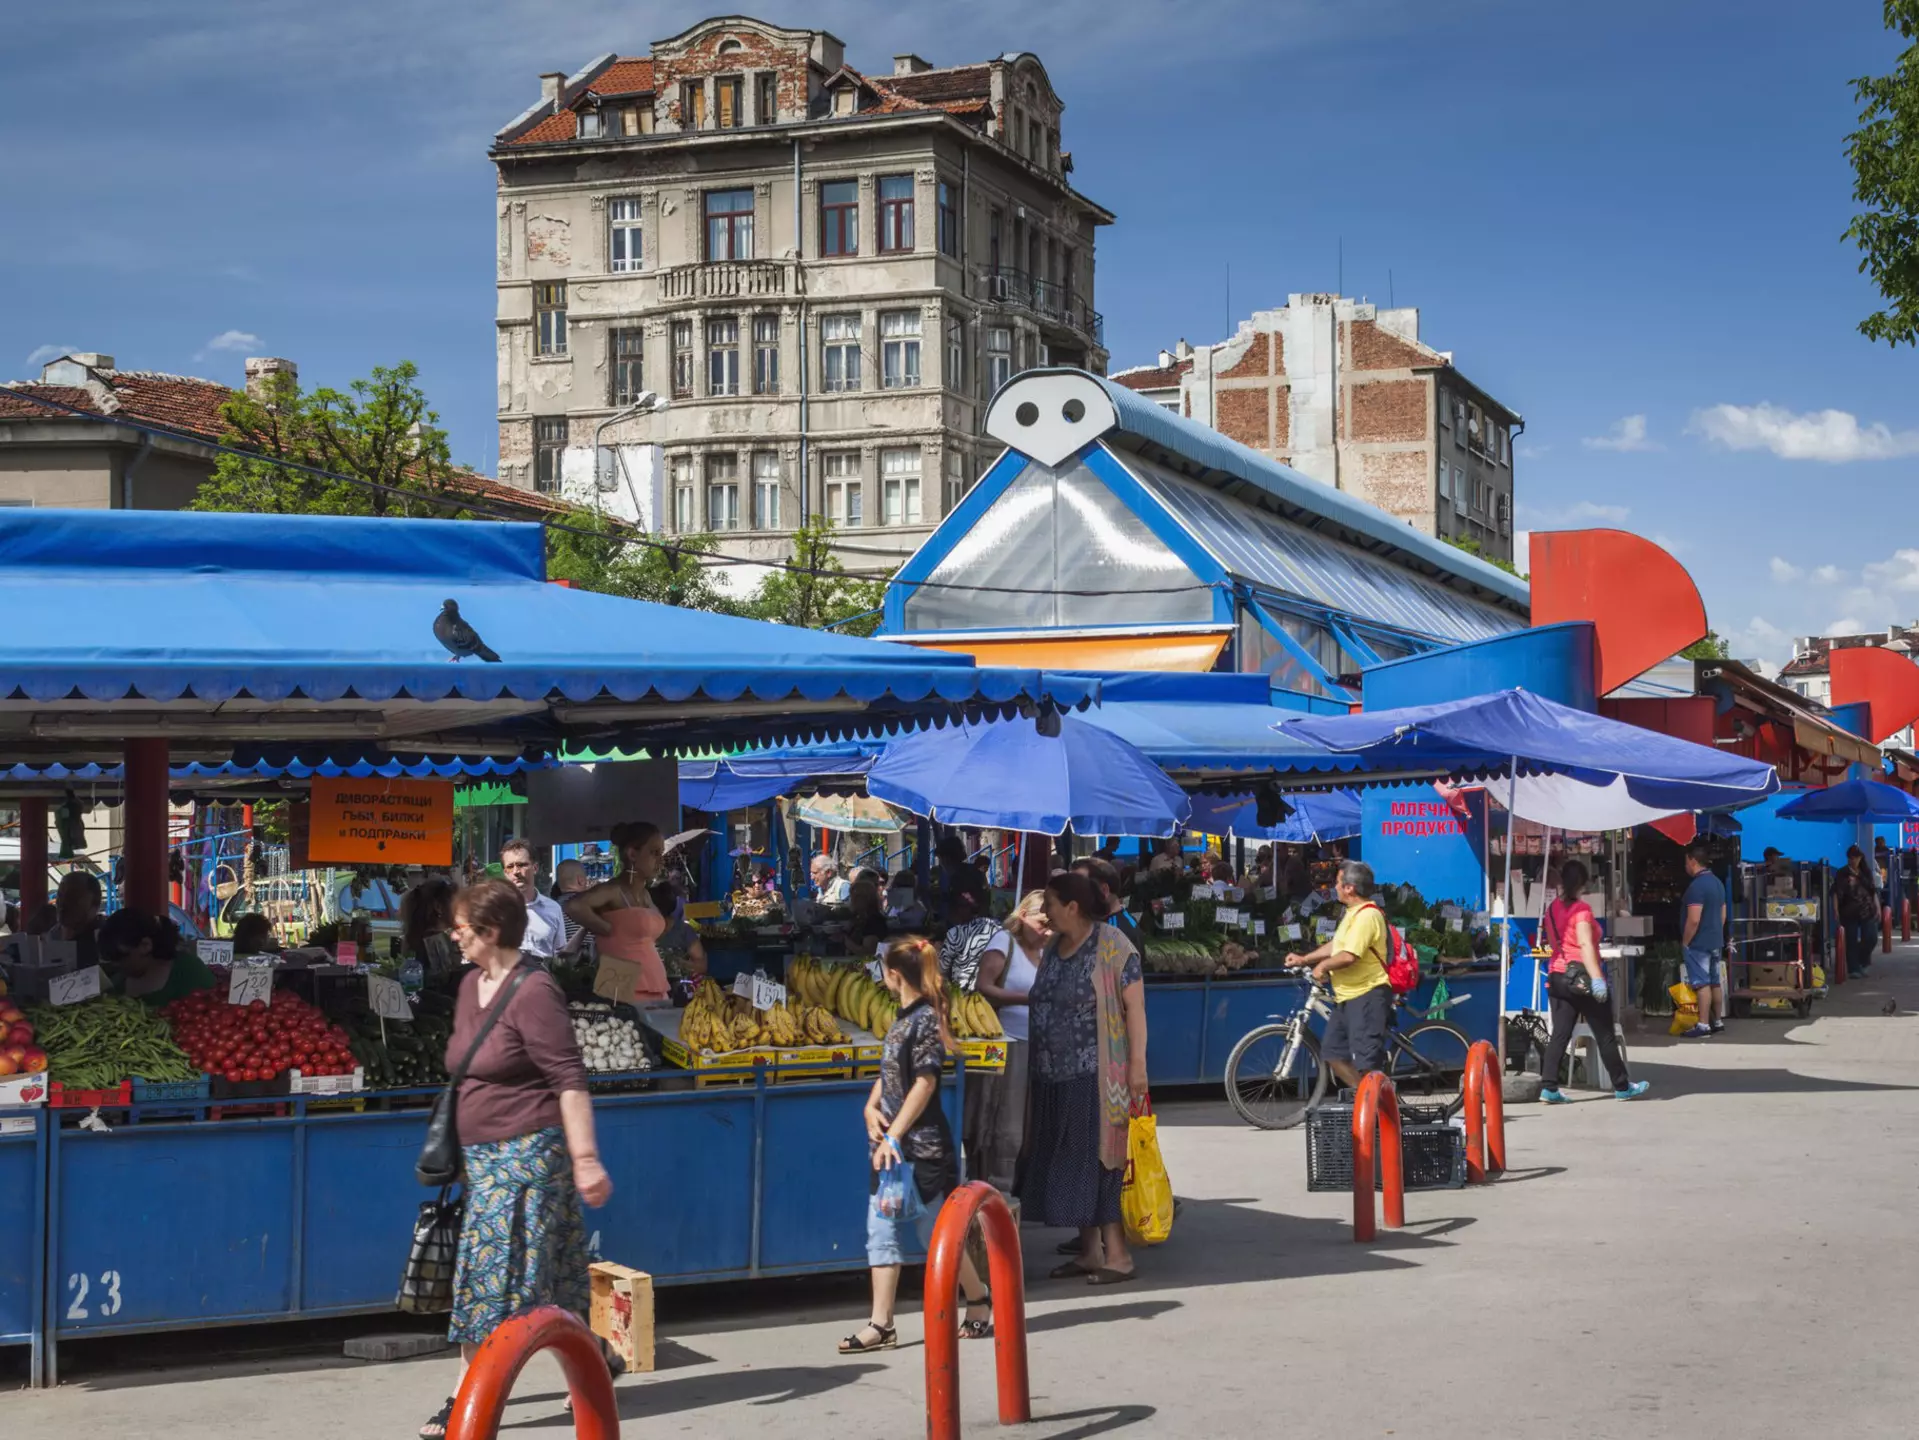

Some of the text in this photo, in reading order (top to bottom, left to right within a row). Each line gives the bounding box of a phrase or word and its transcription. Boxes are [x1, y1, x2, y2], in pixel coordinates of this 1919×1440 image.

[335, 793, 432, 806] ДИВОРАСТЯЩИ
[1391, 802, 1457, 816] МЛЕЧН
[382, 812, 424, 823] БИЛКИ
[350, 828, 426, 840] ПОДПРАВКИ
[1382, 820, 1468, 837] ПРОДУКТИ
[67, 1270, 121, 1319] 23
